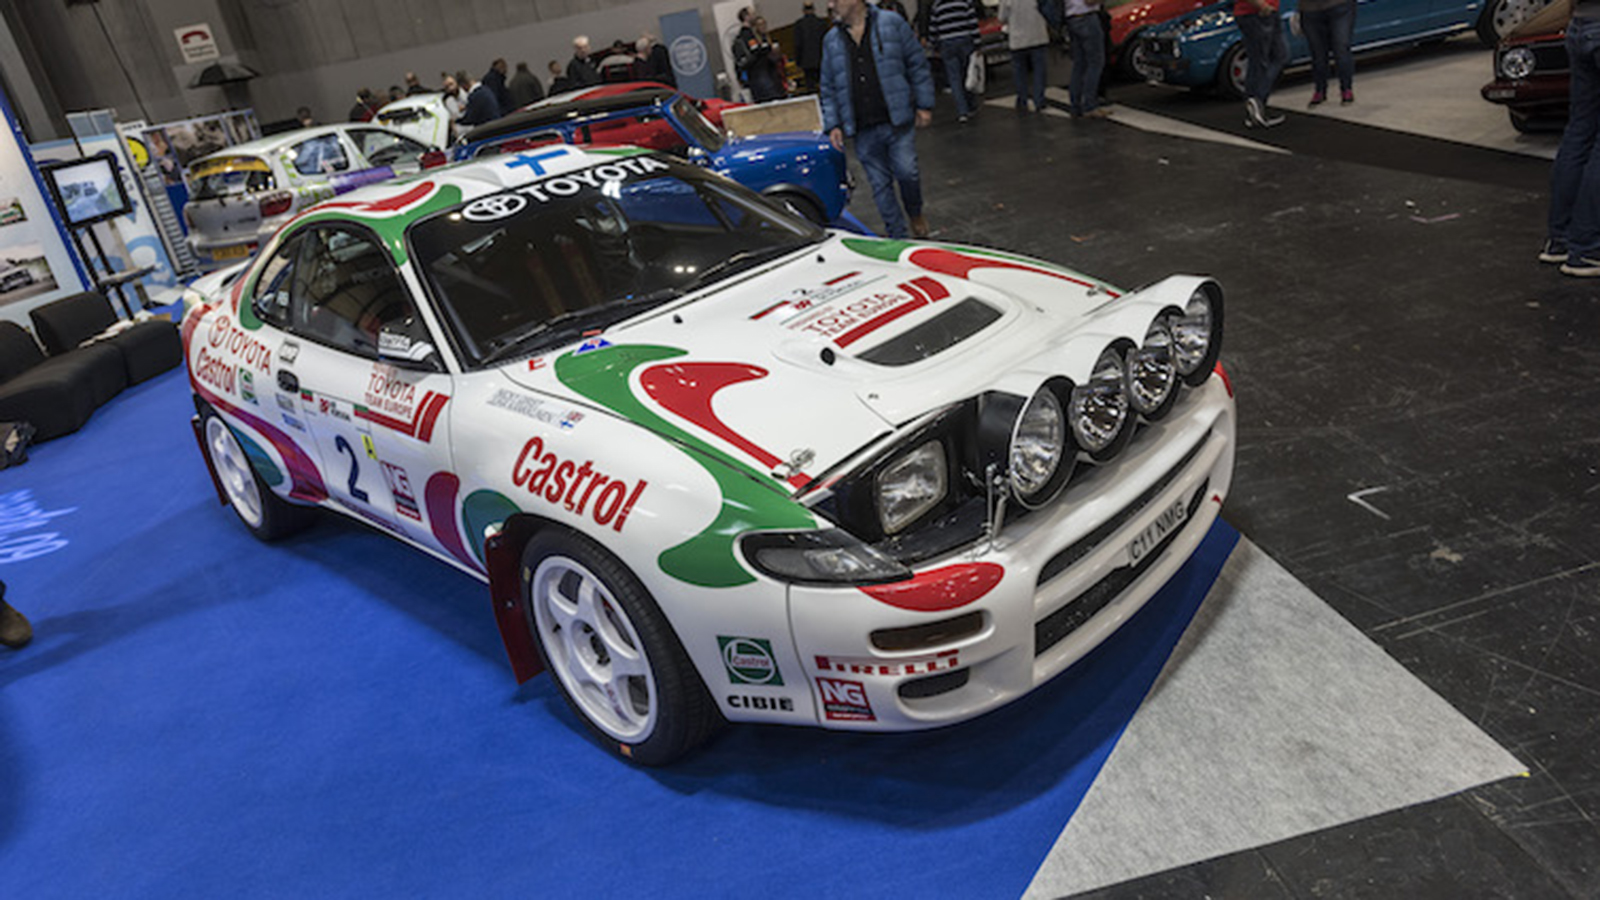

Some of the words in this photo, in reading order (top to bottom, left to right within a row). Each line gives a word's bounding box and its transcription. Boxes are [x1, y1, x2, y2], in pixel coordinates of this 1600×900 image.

[518, 157, 669, 202] TOYOTA
[801, 293, 894, 332] TOYOTA
[820, 318, 857, 337] TEAM
[859, 294, 908, 318] EUROPE
[196, 347, 237, 395] Castrol
[225, 328, 271, 375] TOYOTA
[365, 393, 383, 407] TEAM
[384, 399, 413, 418] EUROPE
[367, 373, 416, 404] TOYOTA
[335, 435, 369, 503] 2
[512, 436, 648, 533] Castrol
[1131, 531, 1155, 560] C11
[1156, 500, 1185, 537] NMG
[733, 656, 769, 667] Castrol
[727, 695, 794, 711] CIBIE
[820, 680, 866, 706] NG
